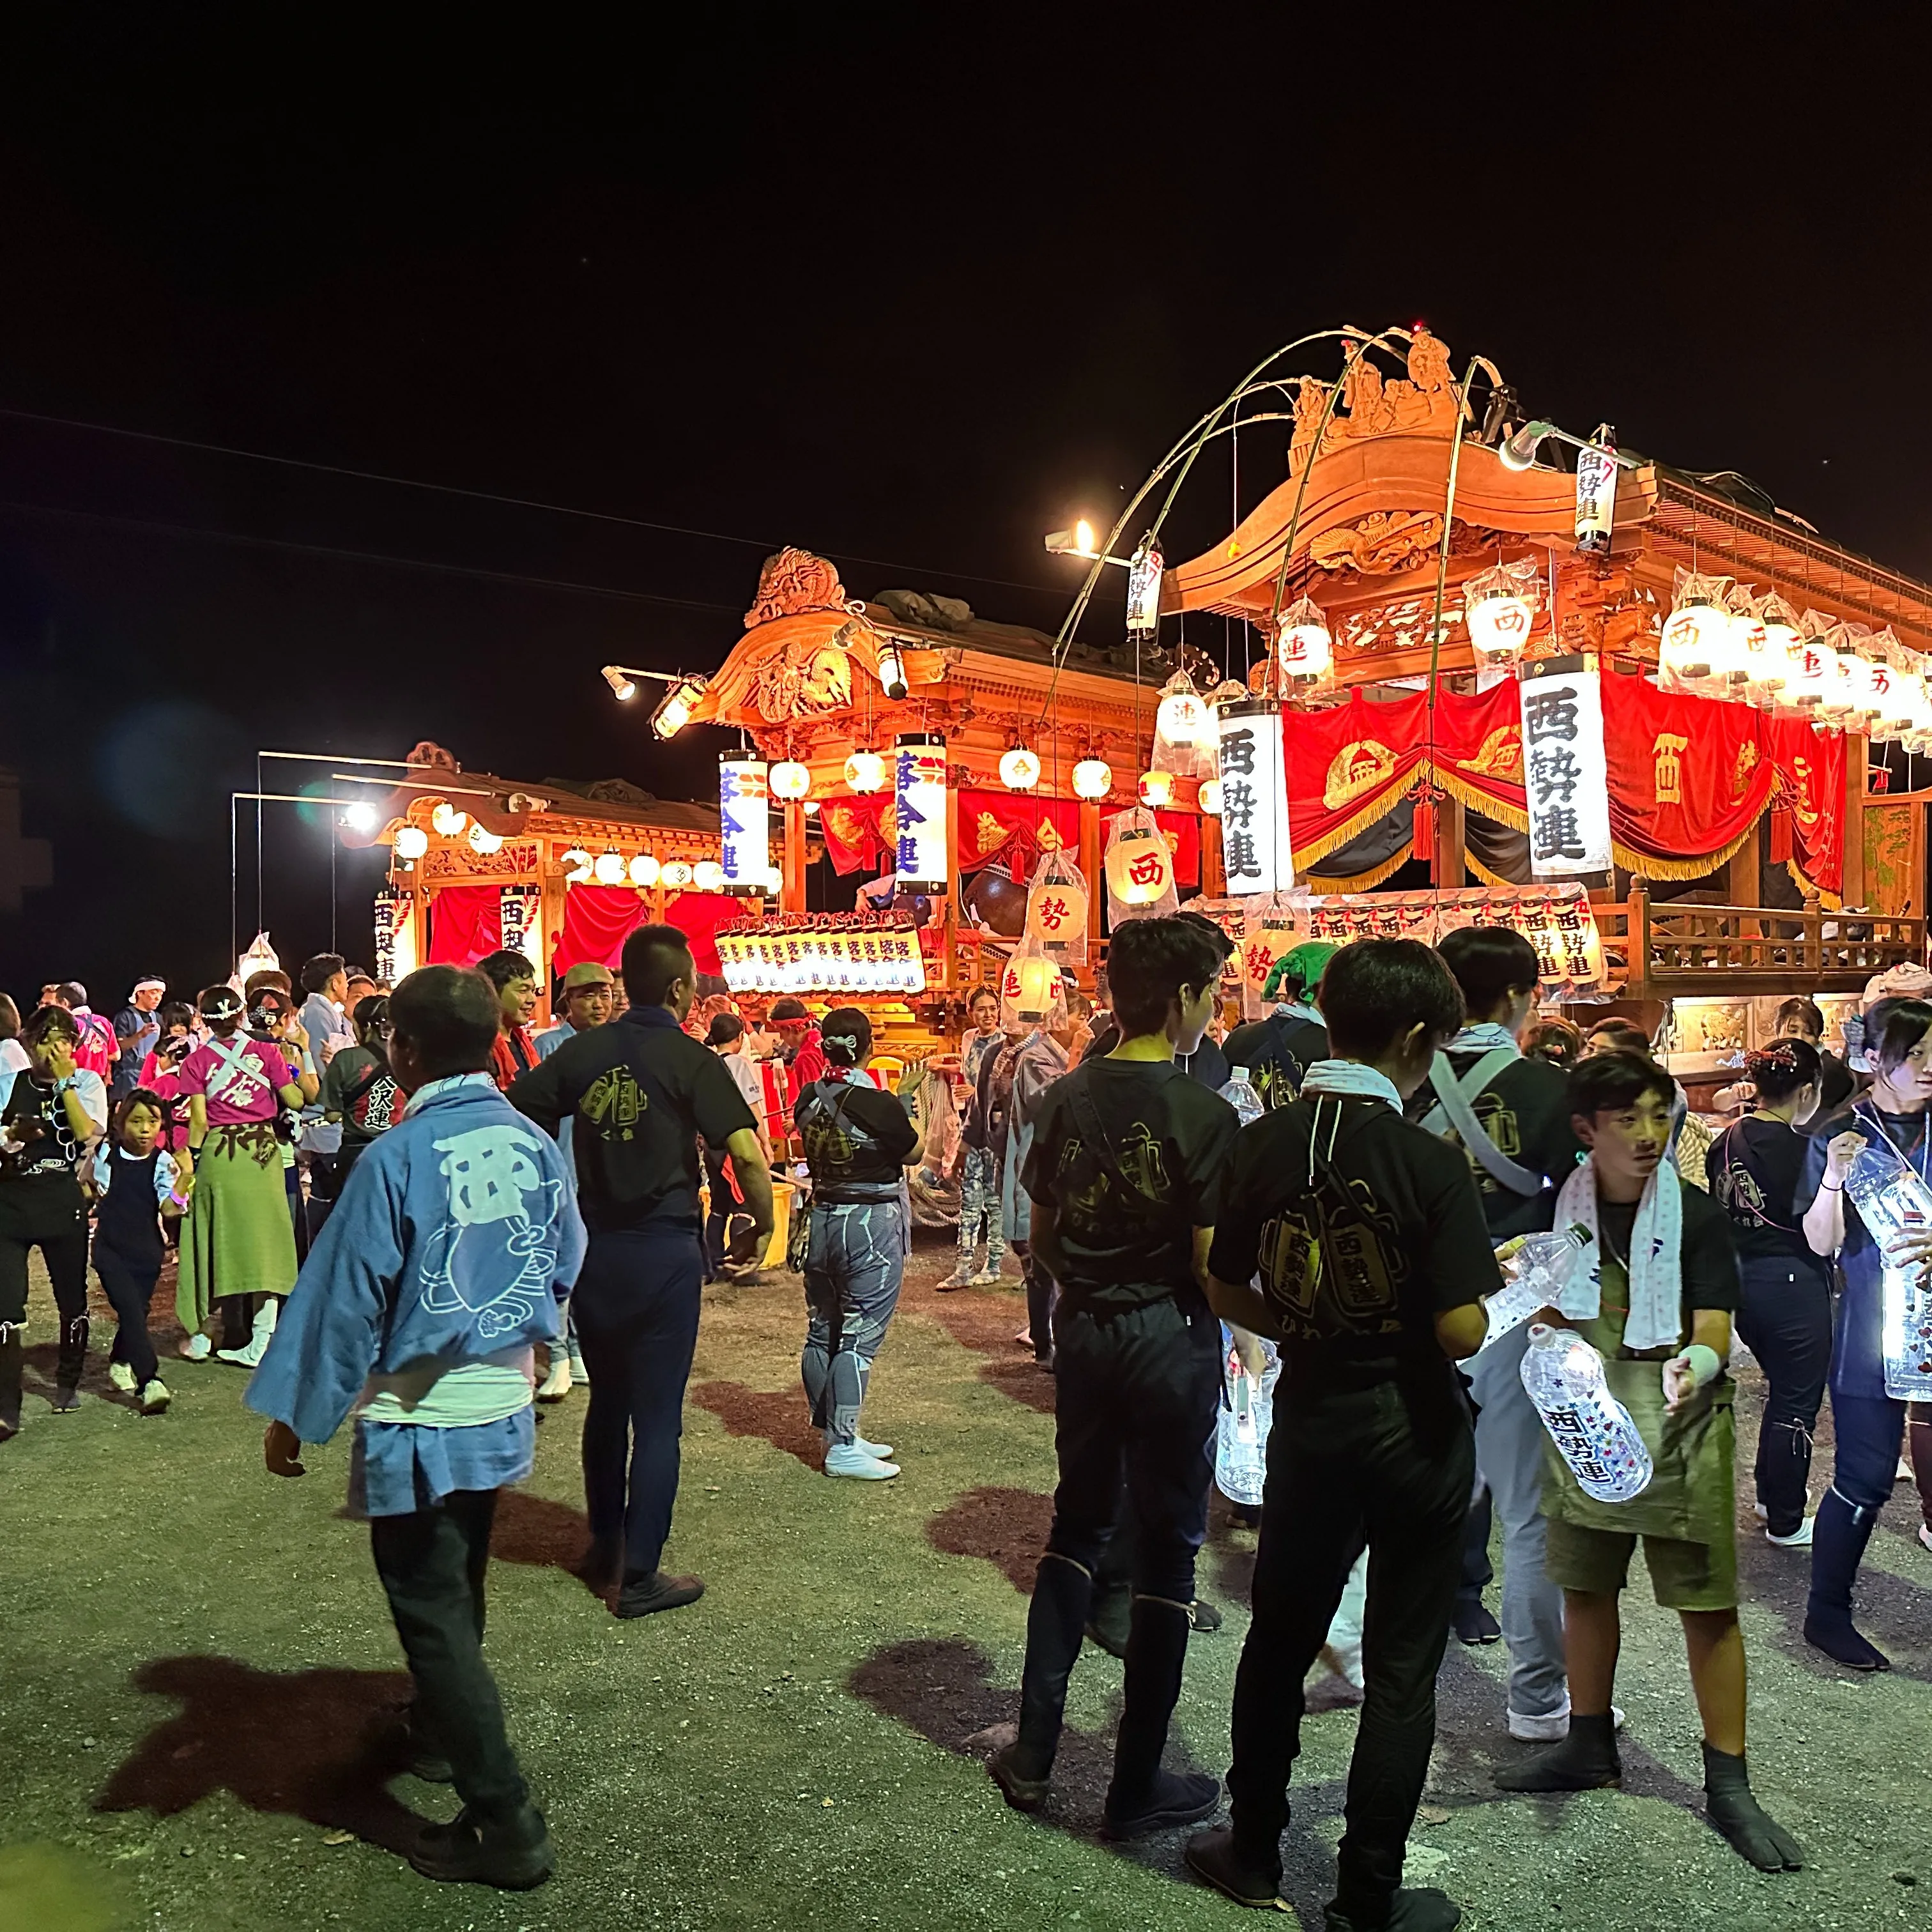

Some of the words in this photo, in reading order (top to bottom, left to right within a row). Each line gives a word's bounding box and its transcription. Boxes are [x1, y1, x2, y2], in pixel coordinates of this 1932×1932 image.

[1494, 606, 1524, 632] 西
[1669, 617, 1700, 647] 西
[1283, 633, 1308, 663] 連
[1747, 626, 1767, 652] 西
[1174, 701, 1197, 725] 連
[1524, 687, 1586, 861] 西勢連
[1129, 852, 1163, 886] 西
[1038, 896, 1070, 931] 勢
[1554, 910, 1592, 976] 西勢連
[1246, 944, 1275, 982] 勢
